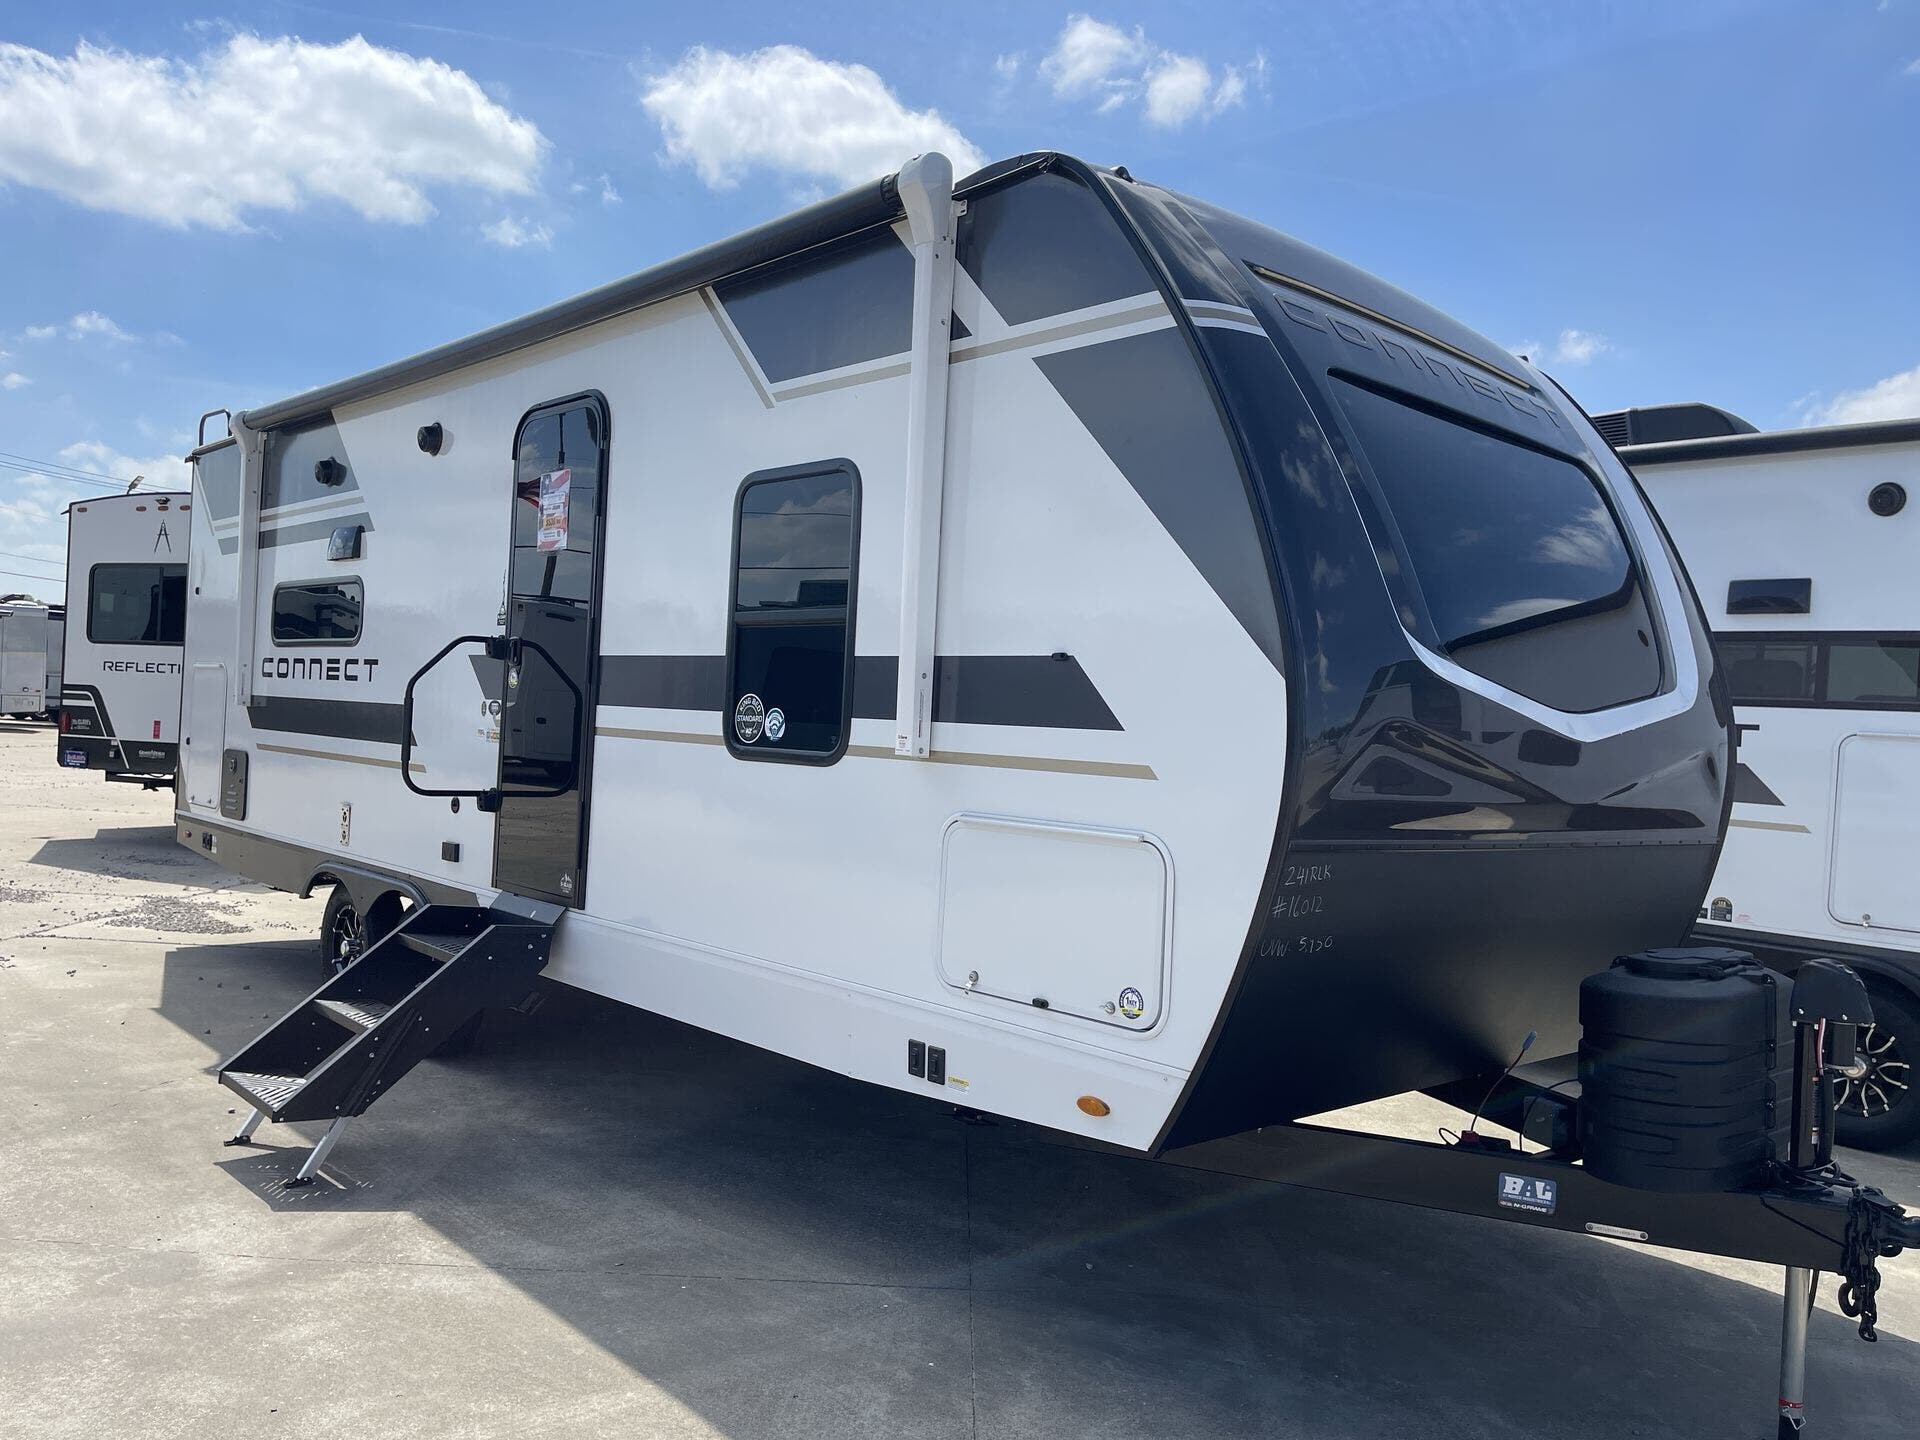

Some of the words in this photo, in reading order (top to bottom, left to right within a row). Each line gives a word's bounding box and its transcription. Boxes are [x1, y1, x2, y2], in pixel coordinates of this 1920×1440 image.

[1273, 292, 1560, 429] CONNECT
[261, 657, 379, 682] CONNECT
[1284, 864, 1332, 886] 241RLK
[1272, 895, 1323, 918] #16012
